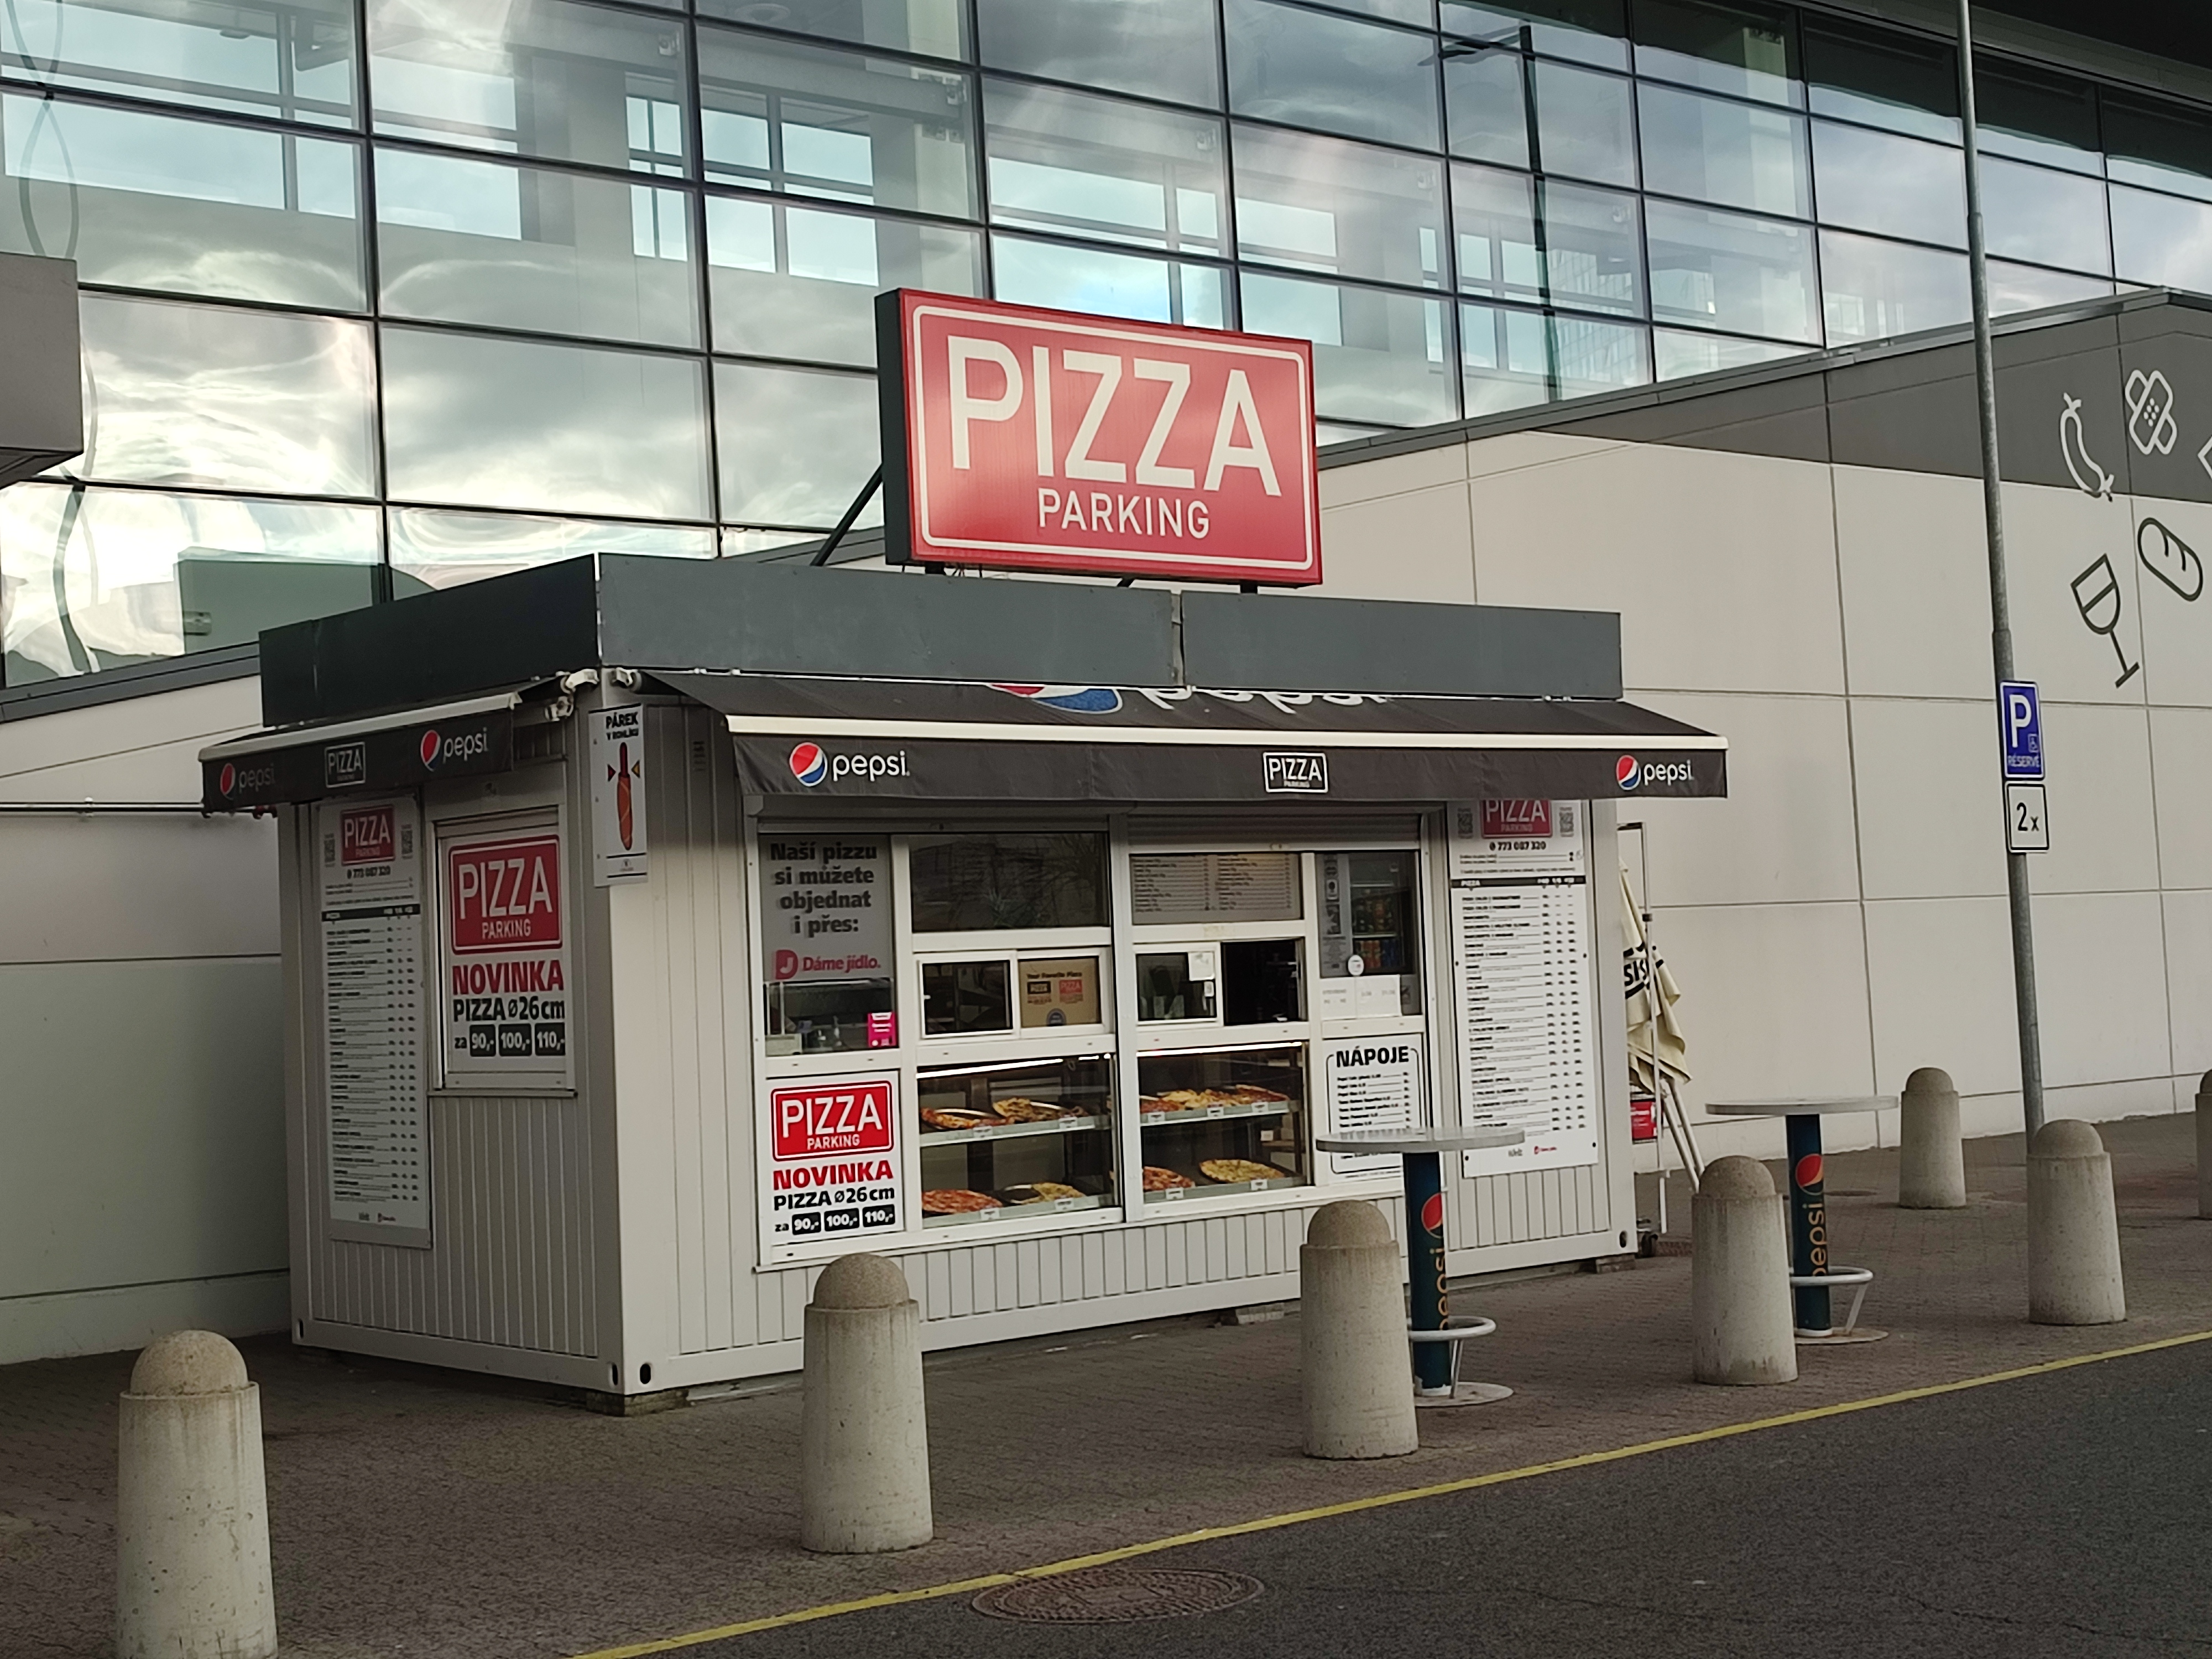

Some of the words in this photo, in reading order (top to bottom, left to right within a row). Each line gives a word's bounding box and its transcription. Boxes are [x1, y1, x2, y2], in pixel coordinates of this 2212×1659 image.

[947, 335, 1281, 496] PIZZA
[1038, 488, 1209, 539] PARKING
[606, 712, 639, 729] PÁREK
[2010, 694, 2032, 748] P
[444, 727, 489, 763] pepsi
[328, 748, 362, 774] PIZZA
[833, 750, 906, 781] pepsi
[1269, 758, 1322, 781] PIZZA
[1644, 759, 1693, 786] pepsi
[2007, 753, 2041, 768] RÉSERVÉ
[1485, 800, 1546, 823] PIZZA
[345, 814, 390, 848] PIZZA
[770, 841, 817, 860] Naší
[823, 841, 878, 864] pizzu
[774, 866, 792, 885] si
[799, 865, 875, 885] můžete
[458, 856, 552, 919] PIZZA
[780, 890, 872, 914] objednat
[482, 919, 531, 939] PARKING
[794, 915, 801, 933] i
[807, 914, 859, 938] přes:
[452, 959, 564, 995] NOVINKA
[453, 998, 506, 1022] PIZZA
[455, 1037, 467, 1049] za
[472, 1032, 494, 1051] 90,-
[500, 1032, 530, 1051] 100,-
[536, 1031, 565, 1051] 110,-
[1336, 1045, 1409, 1068] NÁPOJE
[781, 1093, 883, 1138] PIZZA
[807, 1134, 860, 1150] PARKING
[773, 1160, 894, 1191] NOVINKA
[774, 1191, 832, 1211] PIZZA
[775, 1223, 790, 1232] za
[794, 1218, 820, 1232] 90,-
[826, 1213, 858, 1228] 100,-
[864, 1209, 894, 1223] 110,-
